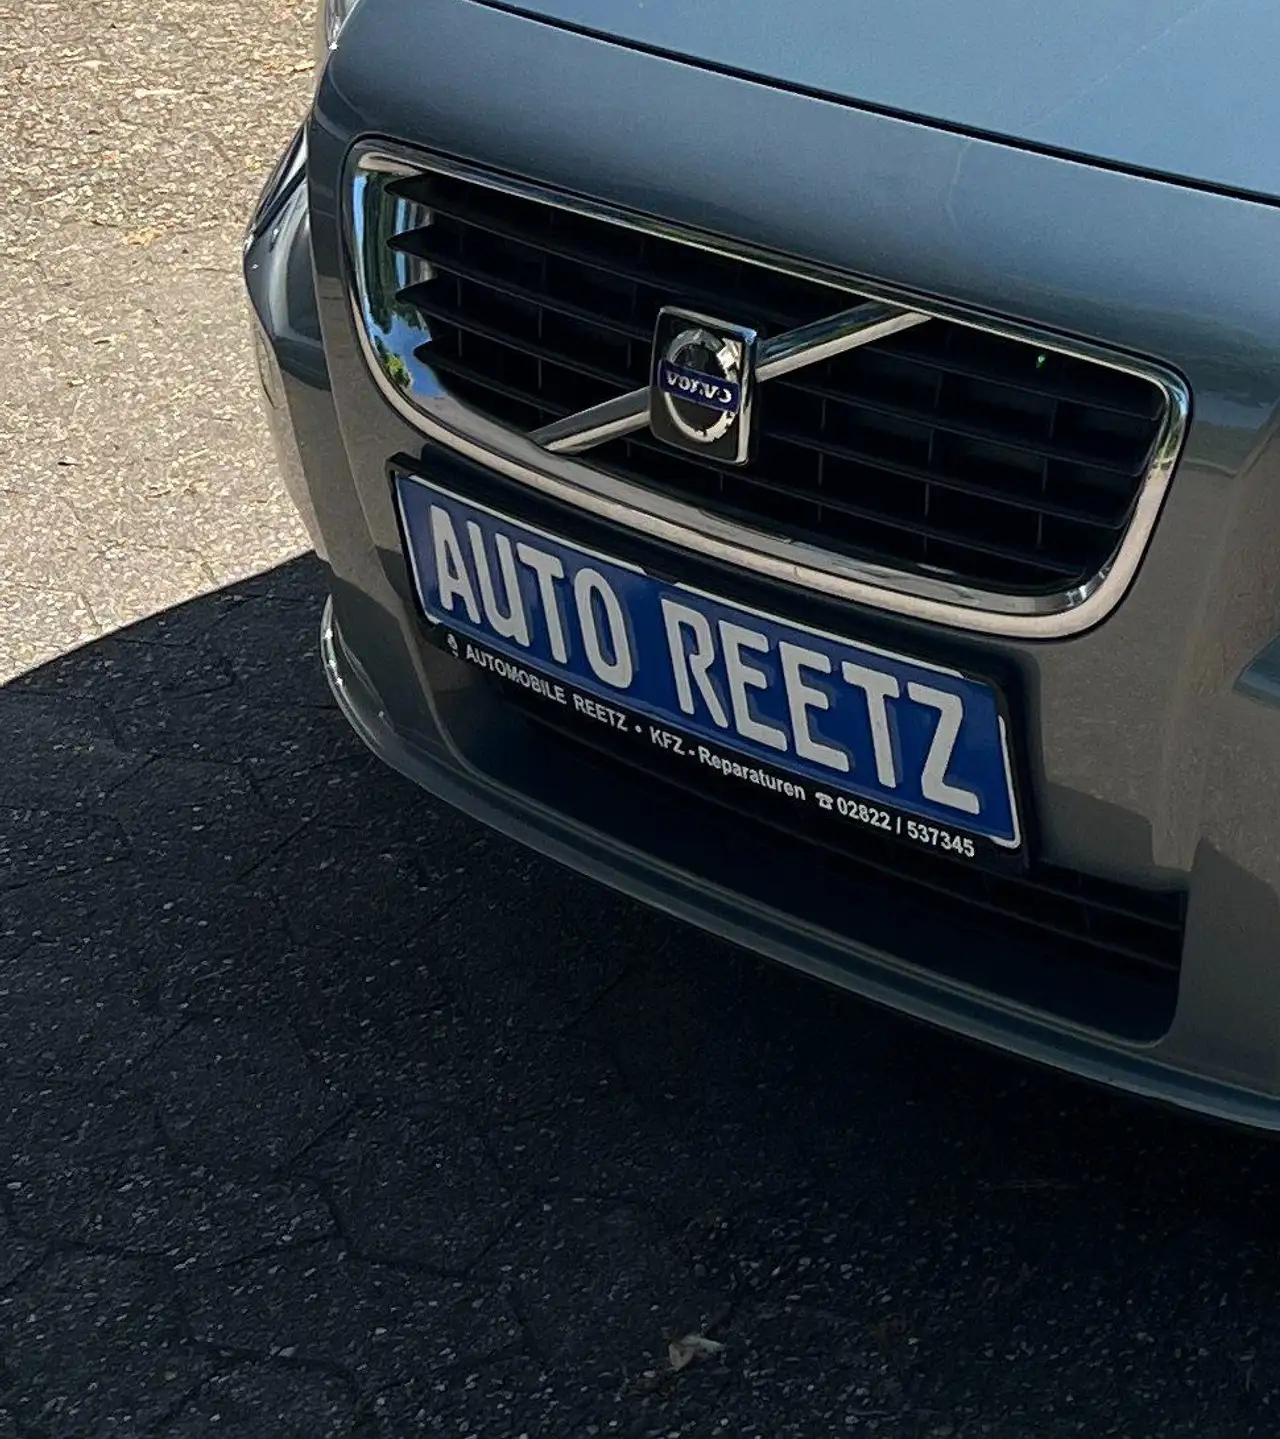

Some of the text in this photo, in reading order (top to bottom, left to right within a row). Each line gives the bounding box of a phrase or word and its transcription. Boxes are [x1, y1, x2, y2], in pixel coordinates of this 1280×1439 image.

[666, 370, 733, 404] VOLVO
[429, 505, 981, 816] AUTO REETZ
[466, 644, 568, 705] AUTOMOBILE
[573, 693, 629, 732] REETZ
[837, 799, 893, 831] 02822
[907, 821, 976, 857] 537345
